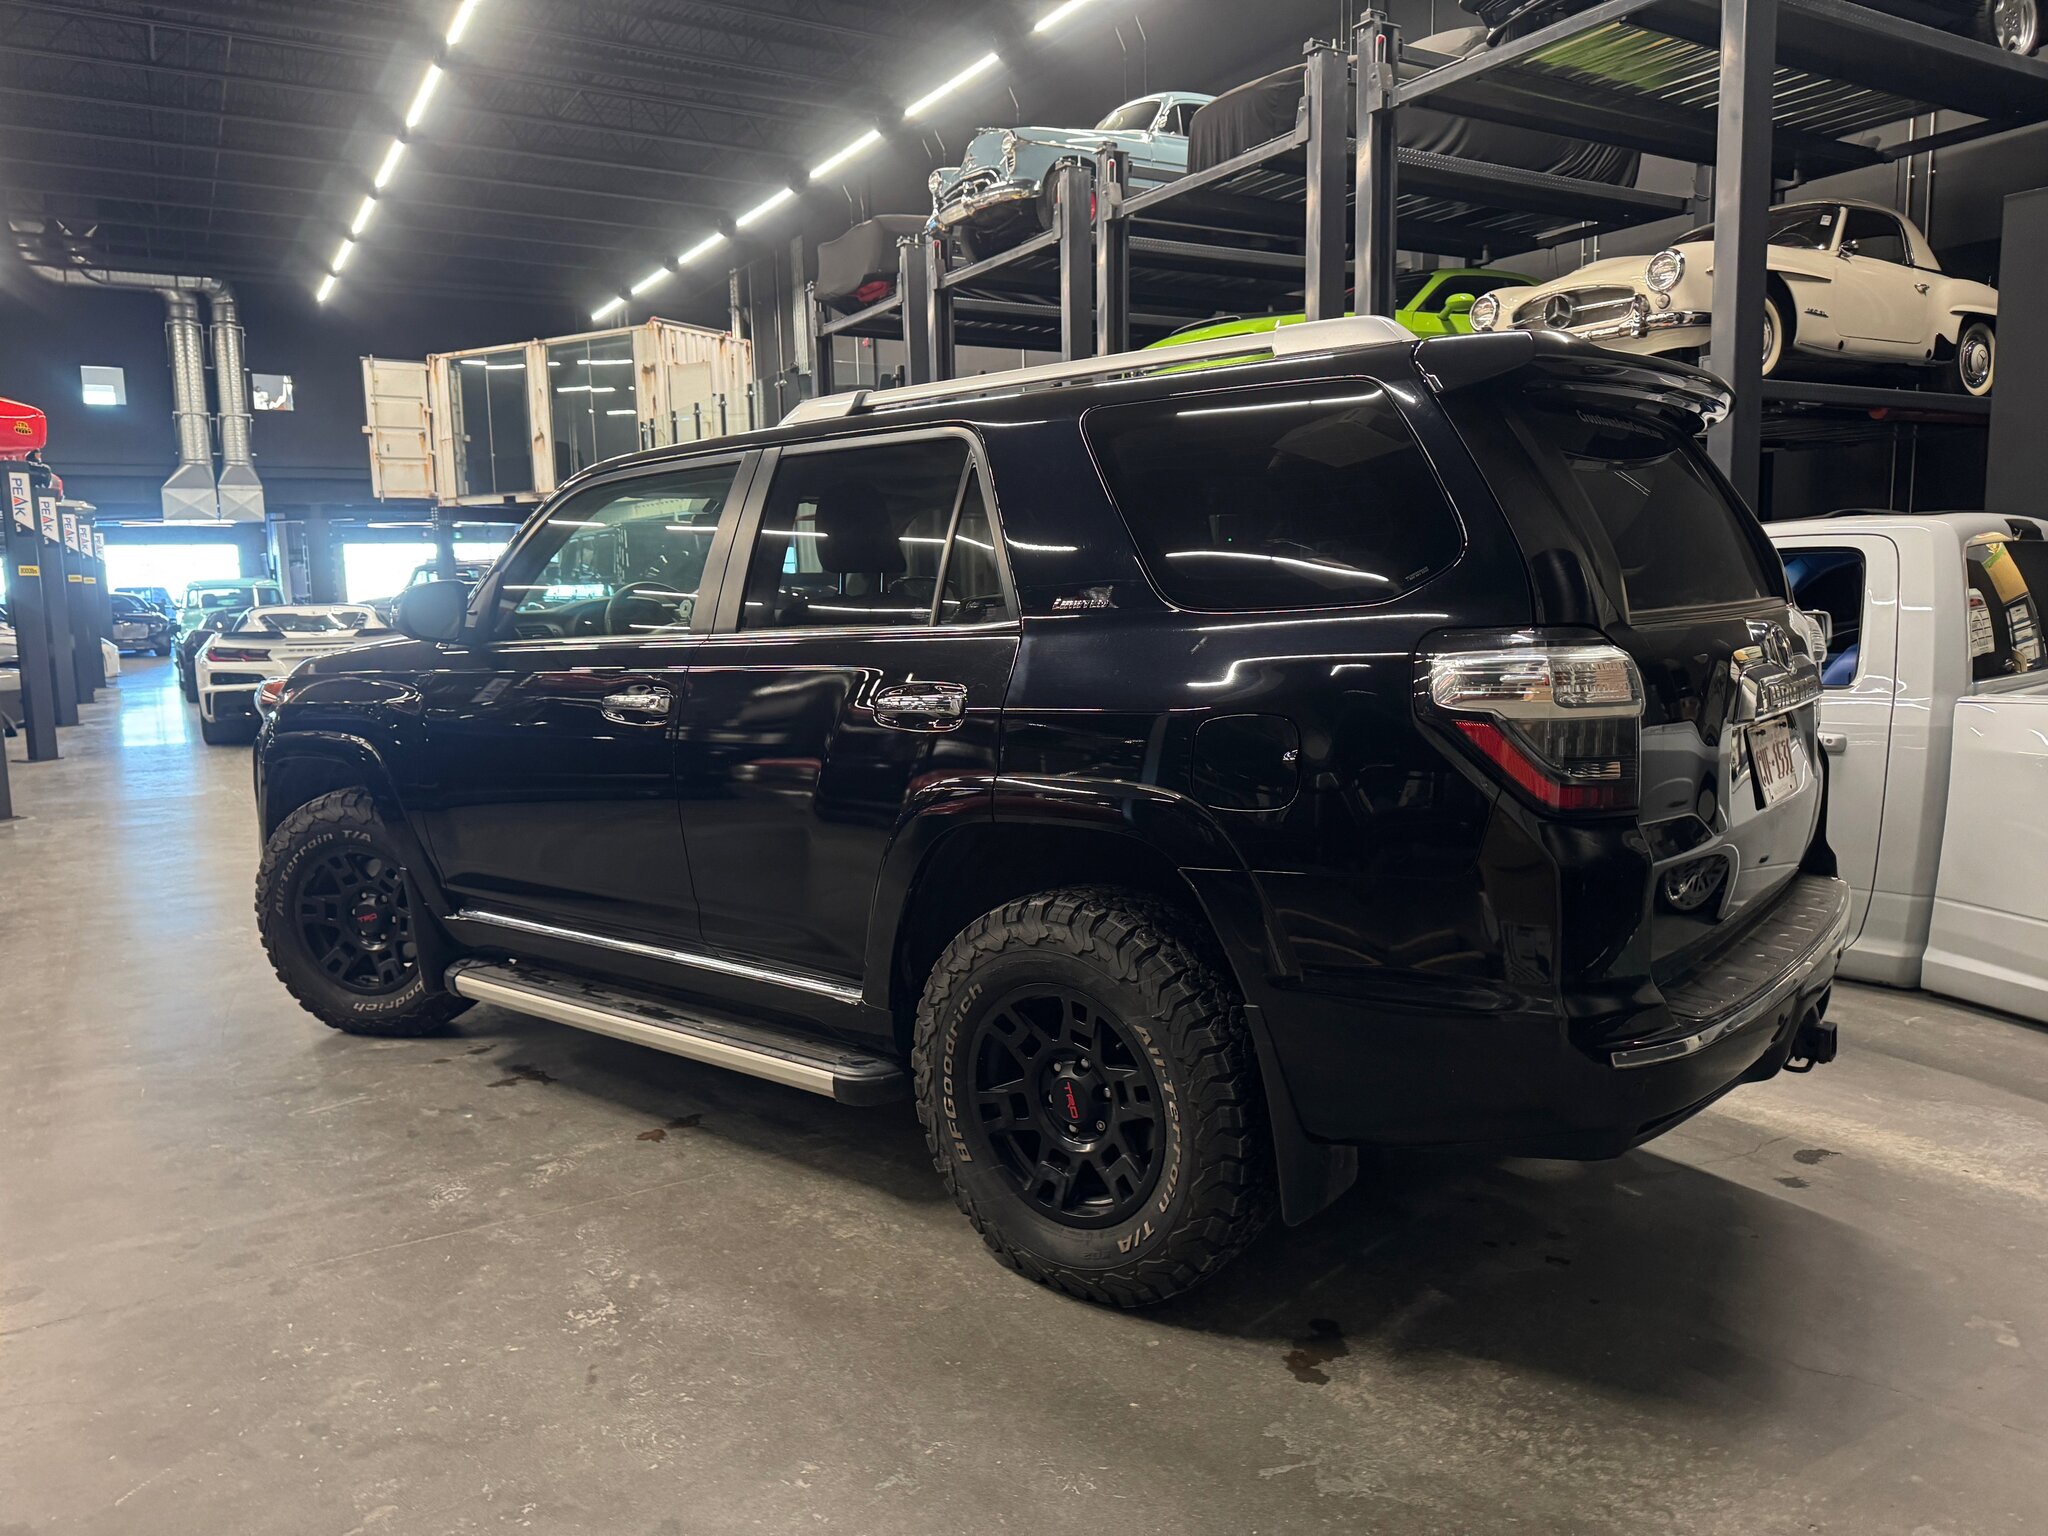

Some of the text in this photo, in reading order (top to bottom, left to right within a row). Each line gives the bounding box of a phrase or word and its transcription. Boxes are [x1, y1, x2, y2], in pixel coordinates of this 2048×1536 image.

[11, 478, 29, 517] PEAK
[40, 500, 55, 532] PEAK
[64, 517, 76, 543] PEAK
[79, 527, 90, 550] PEAK
[275, 829, 372, 917] All-Terrain T/A
[352, 980, 424, 1012] oodrich
[1063, 1081, 1080, 1120] TRD
[1117, 1024, 1182, 1253] All-Terrain T/A
